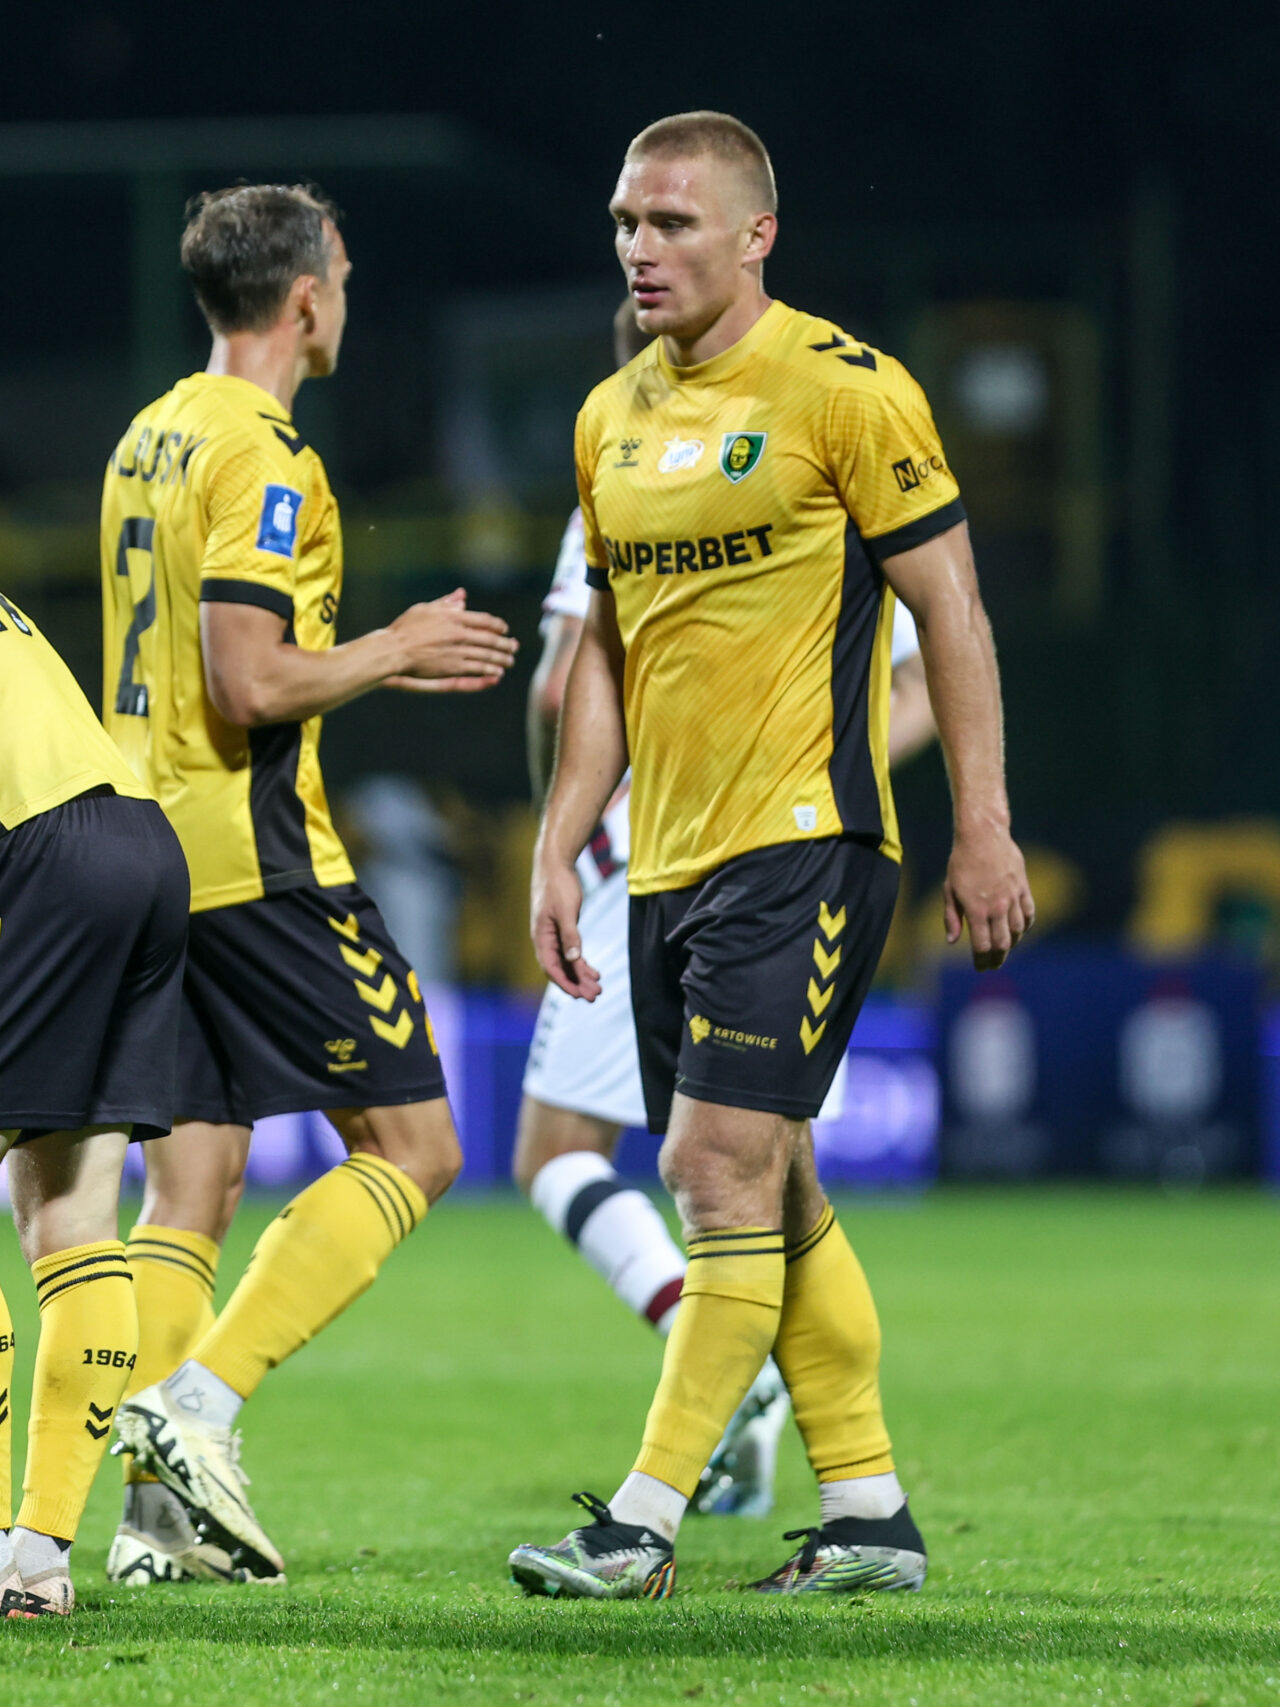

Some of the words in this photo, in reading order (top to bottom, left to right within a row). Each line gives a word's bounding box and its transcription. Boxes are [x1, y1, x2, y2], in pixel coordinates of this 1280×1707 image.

[115, 516, 156, 717] 2
[713, 1026, 778, 1049] KATOWICE
[82, 1348, 137, 1371] 1964
